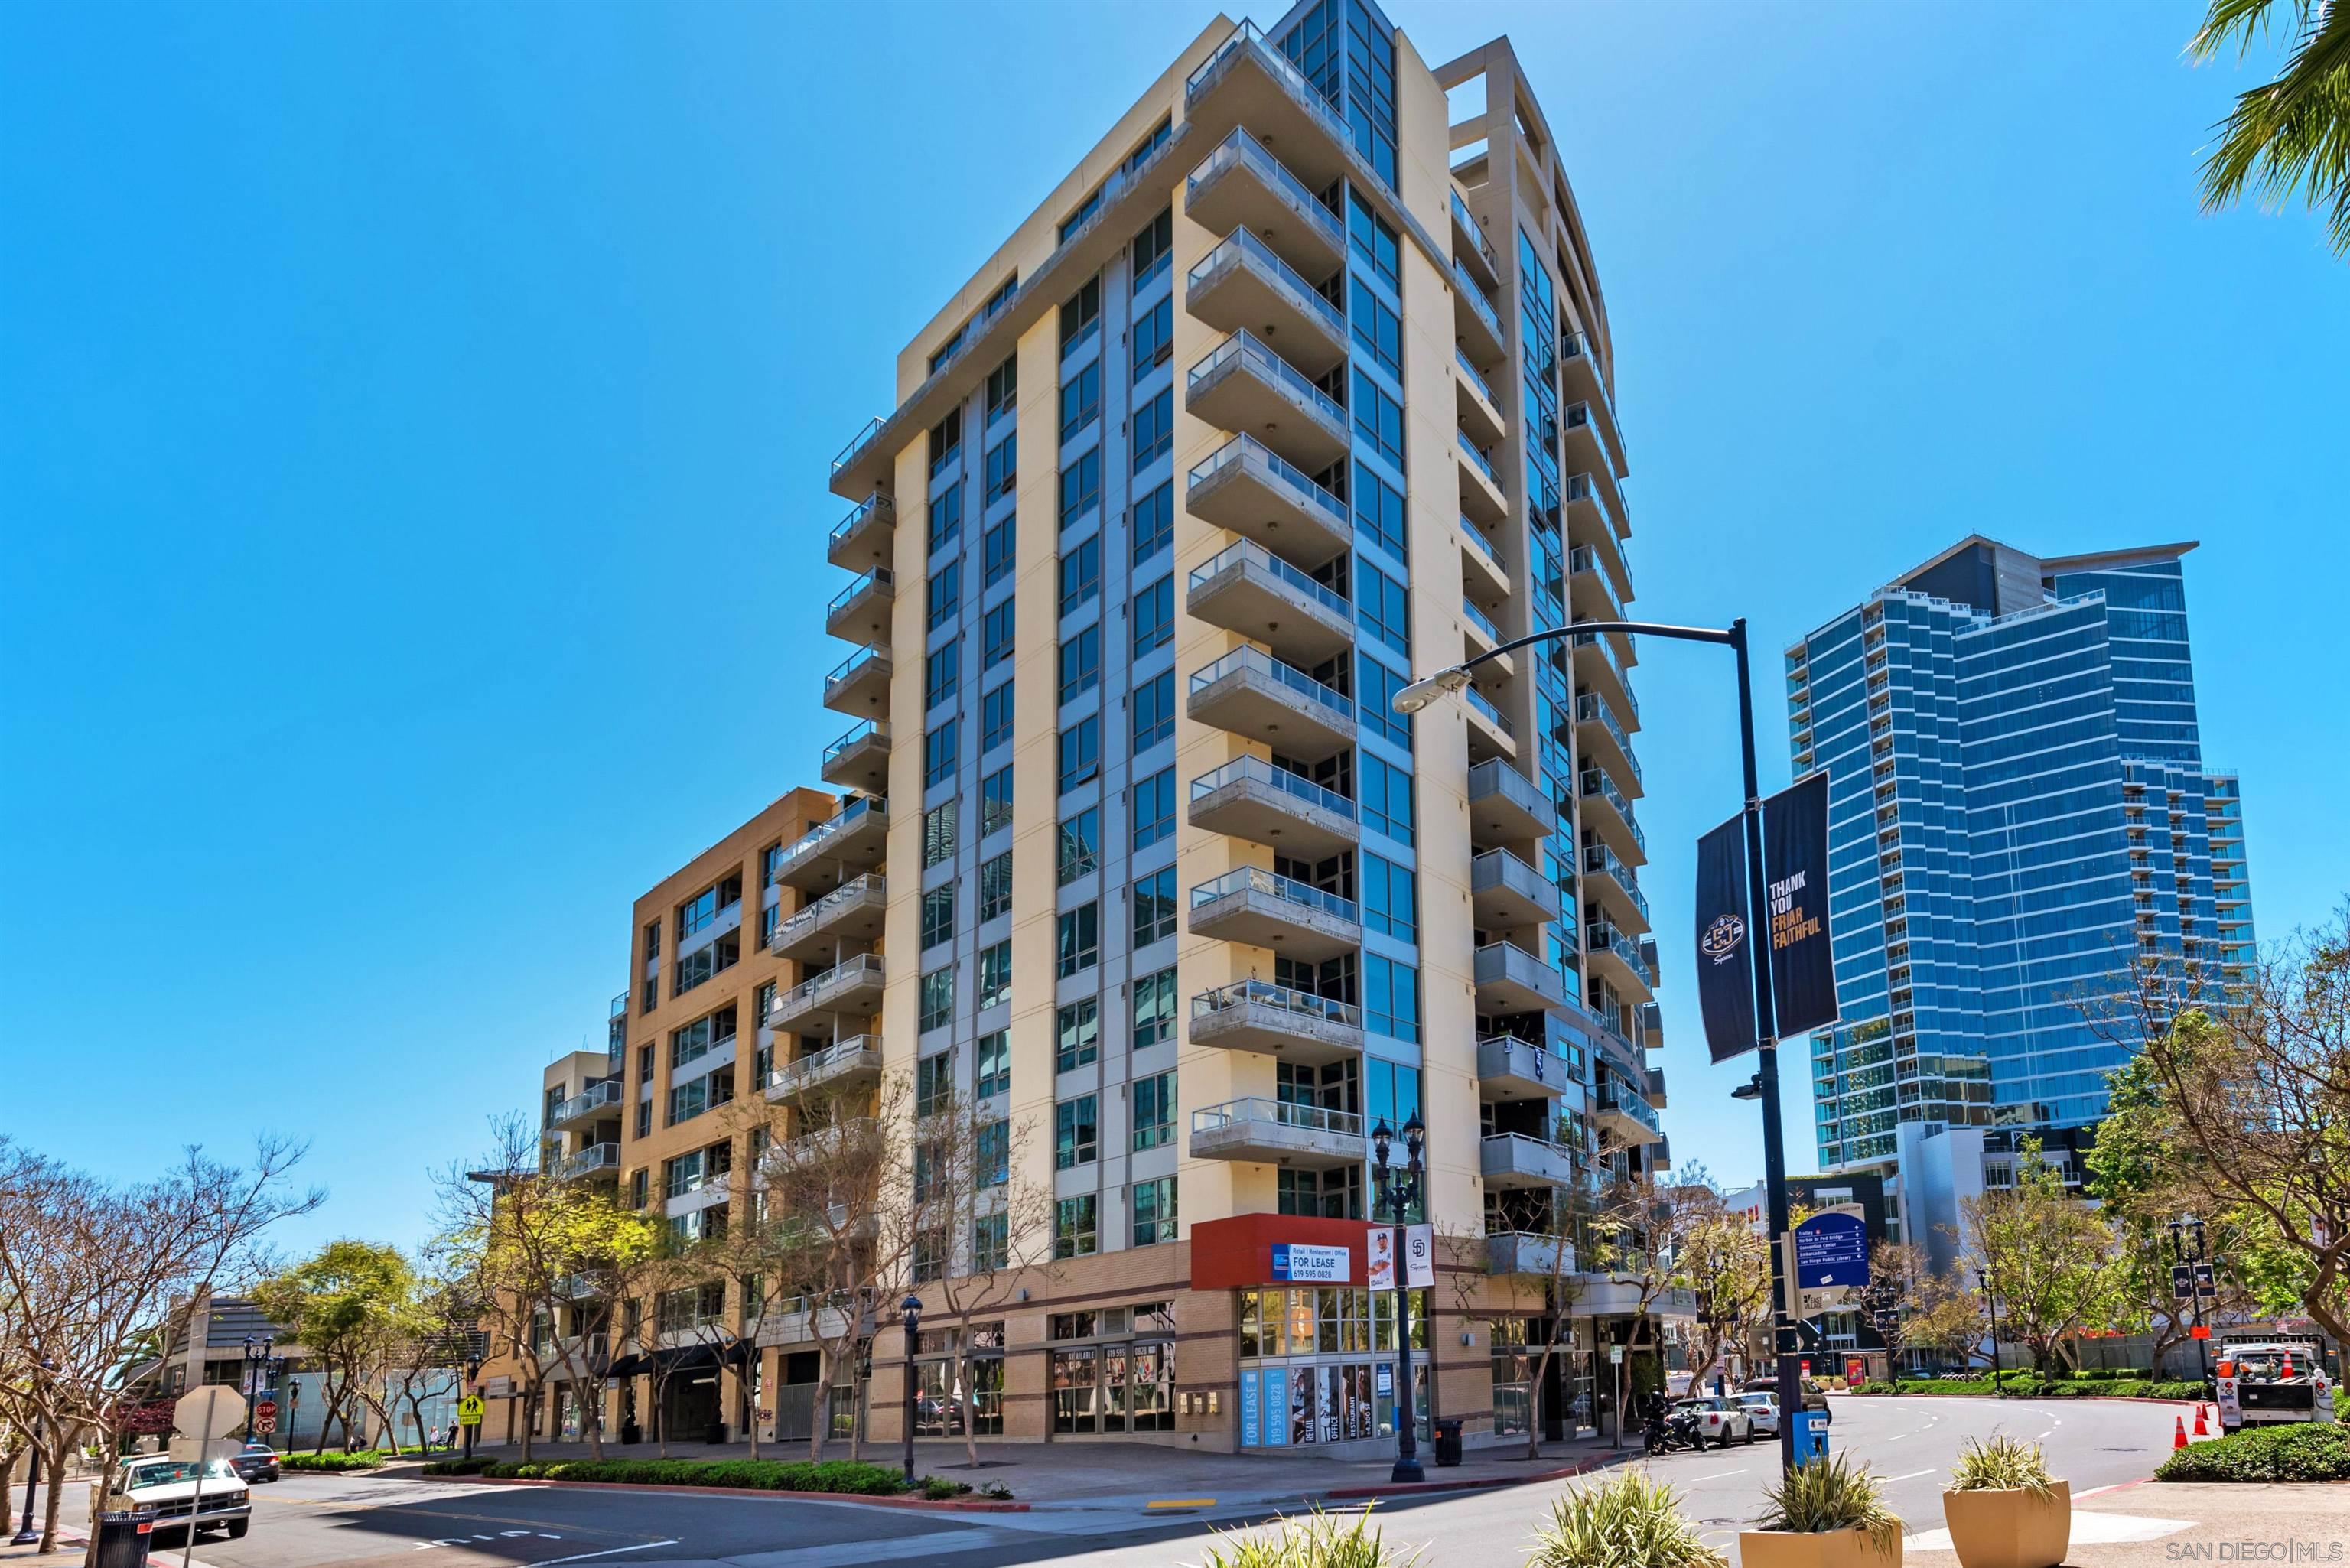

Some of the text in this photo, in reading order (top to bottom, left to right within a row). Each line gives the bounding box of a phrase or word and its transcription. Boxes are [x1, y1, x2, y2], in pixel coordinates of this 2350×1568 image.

[1769, 870, 1806, 900] THANK
[1770, 893, 1792, 916] YOU
[1772, 906, 1803, 933] FRIAR
[1773, 916, 1821, 950] FAITHFUL
[1412, 1239, 1425, 1257] SD
[1293, 1257, 1309, 1267] FOR
[1311, 1257, 1335, 1268] LEASE
[1294, 1270, 1332, 1279] 619 595 0828
[1068, 1351, 1095, 1361] AVAILABLE
[1107, 1346, 1147, 1358] 619 595 0828
[1271, 1384, 1281, 1407] 0828
[1246, 1386, 1257, 1445] FOR LEASE
[1271, 1408, 1281, 1426] 595
[1271, 1428, 1281, 1444] 619
[1305, 1419, 1314, 1441] RETAIL
